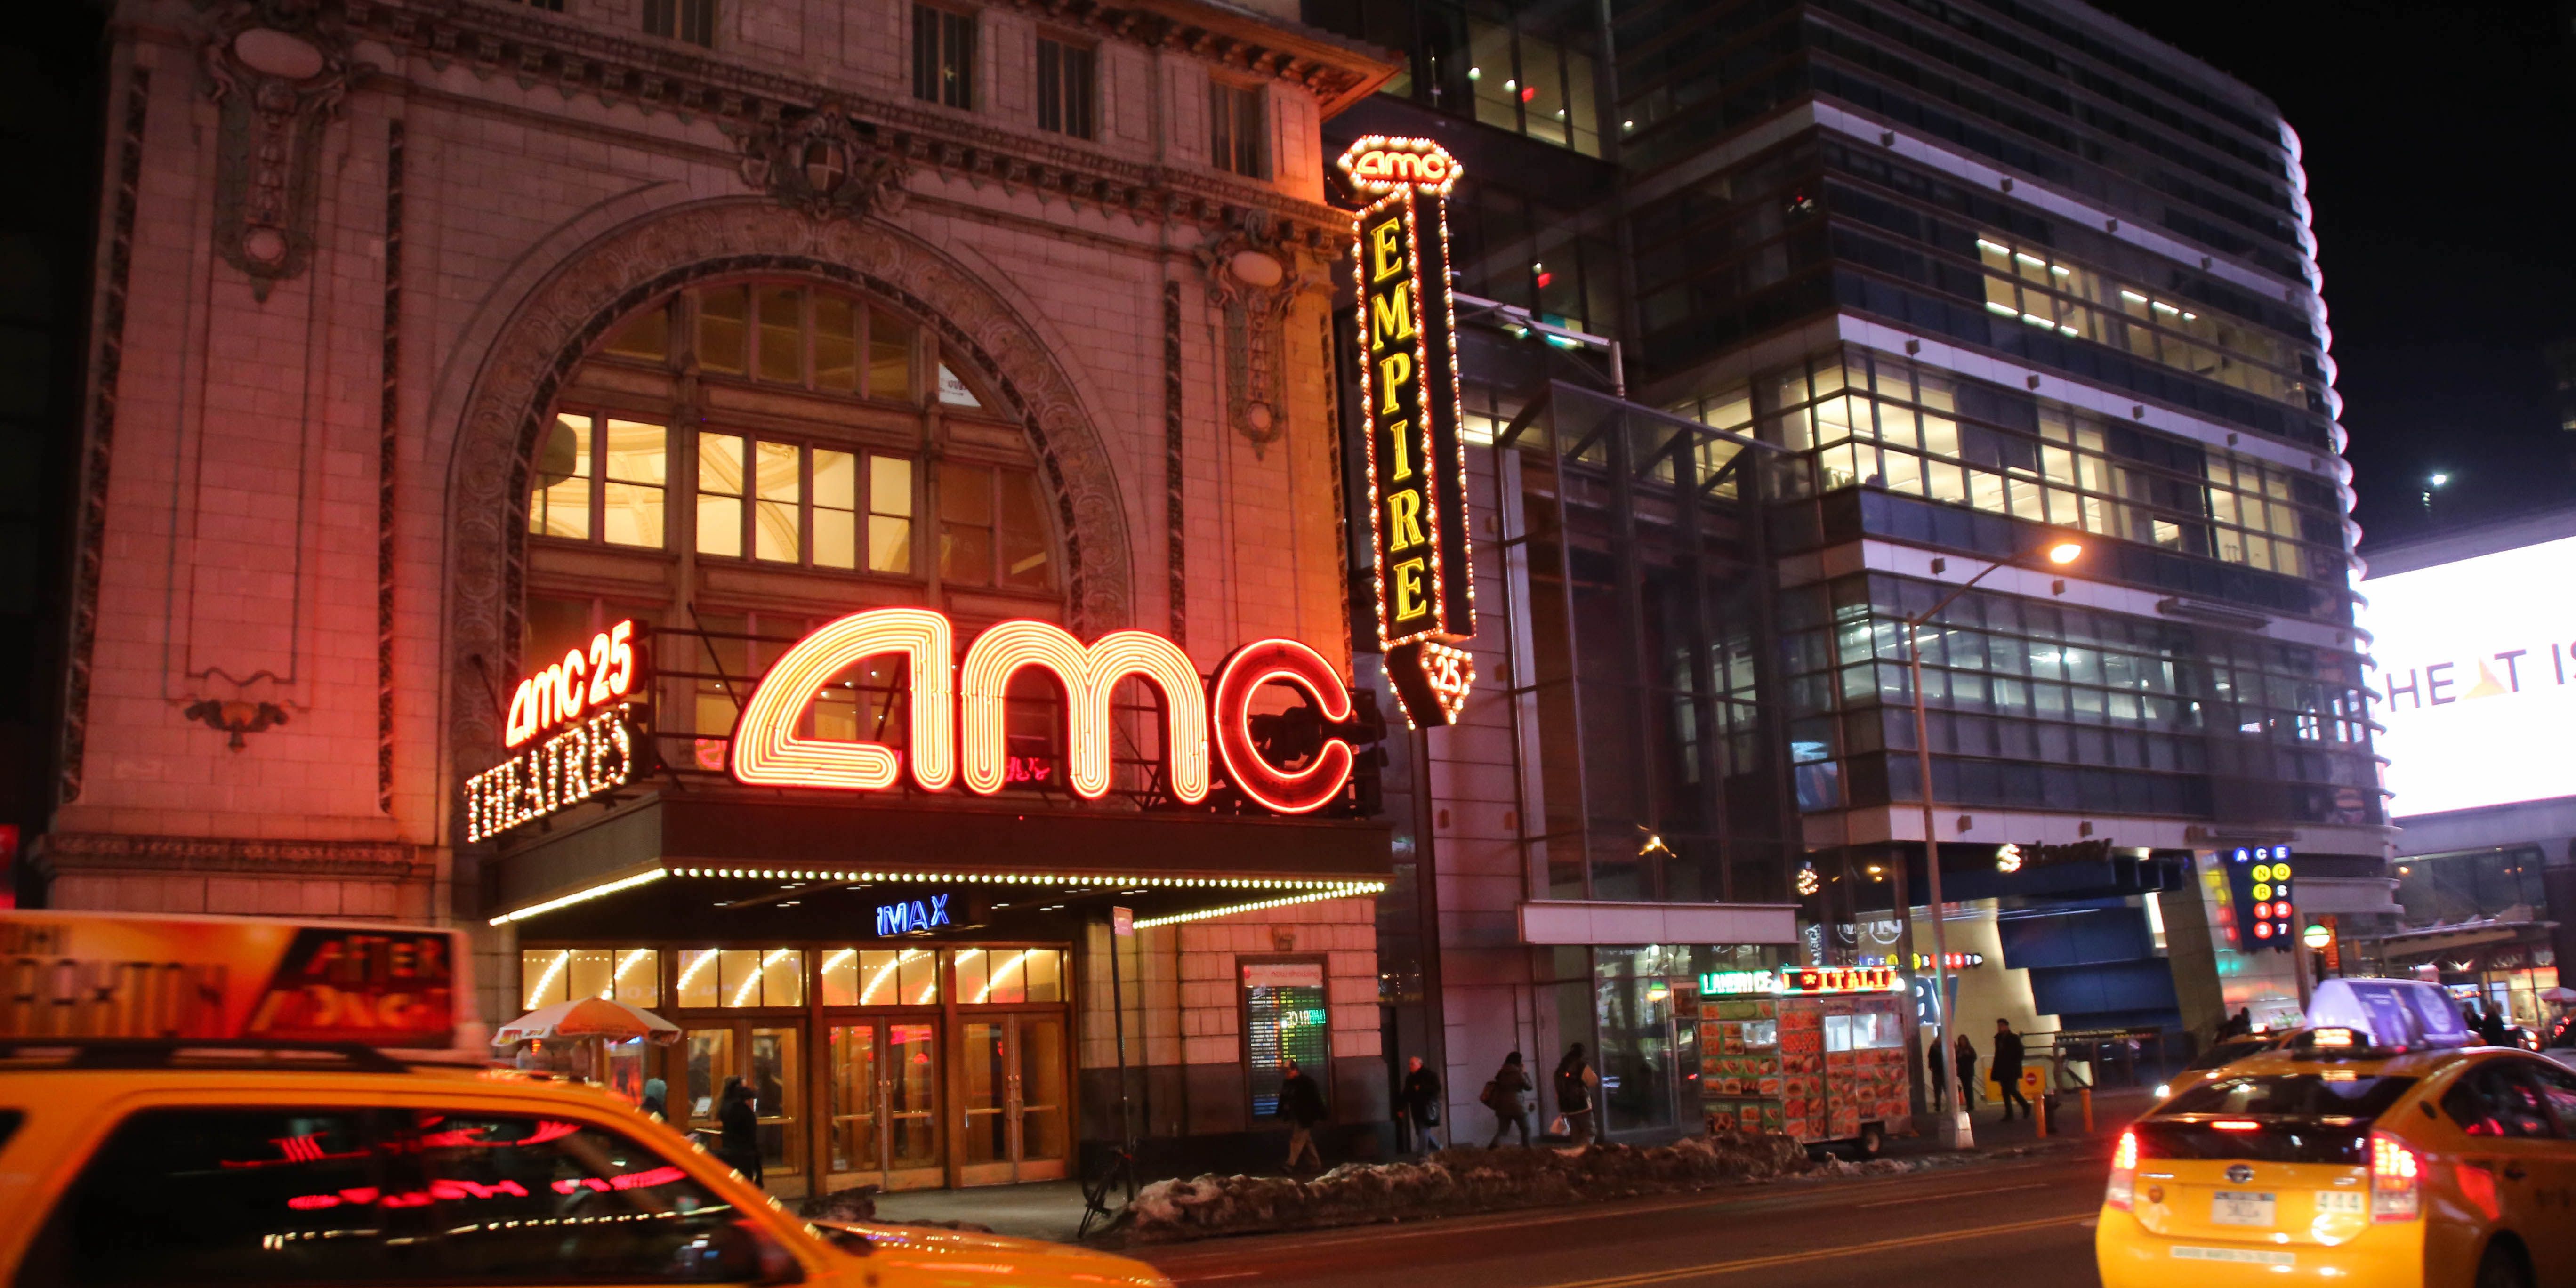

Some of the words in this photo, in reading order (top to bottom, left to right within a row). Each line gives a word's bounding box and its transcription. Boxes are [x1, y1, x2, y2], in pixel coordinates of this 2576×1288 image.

[1356, 150, 1446, 179] amc
[1371, 217, 1426, 622] EMPIRE
[506, 649, 585, 748] amc
[589, 619, 631, 705] 25
[1435, 655, 1461, 693] 25
[733, 607, 1352, 813] amc
[464, 702, 631, 843] THEATRES
[2237, 850, 2248, 861] A
[2256, 848, 2267, 860] C
[2276, 847, 2286, 858] E
[2259, 905, 2266, 916] 1
[2278, 903, 2287, 915] 2
[2277, 885, 2287, 897] S
[877, 894, 950, 936] IMAX
[2259, 924, 2268, 935] 3
[2278, 923, 2287, 934] 7
